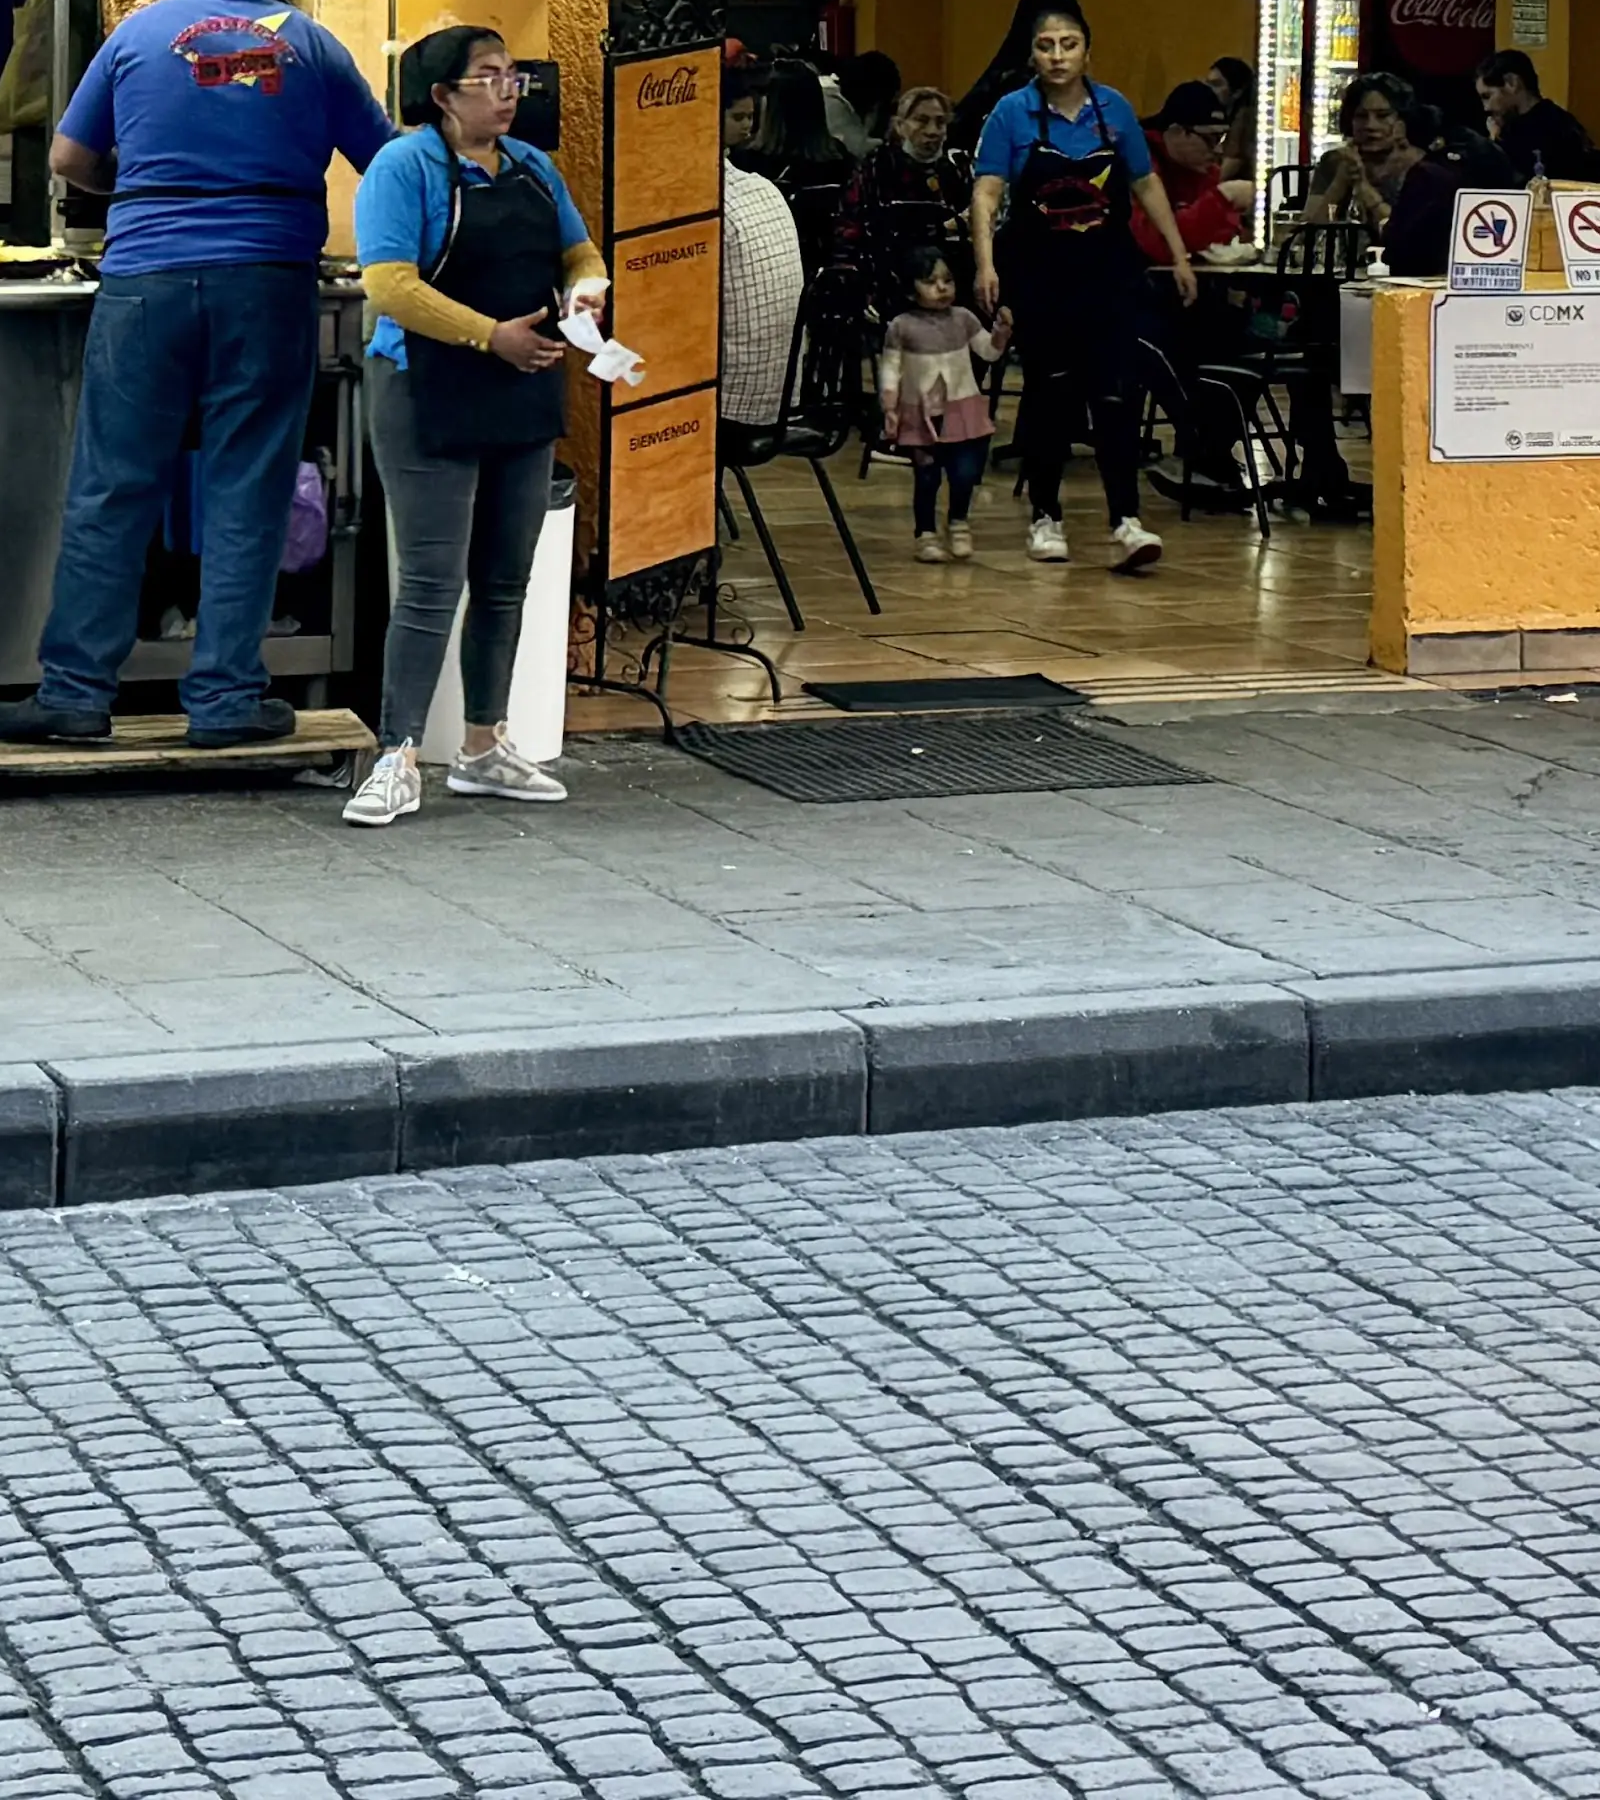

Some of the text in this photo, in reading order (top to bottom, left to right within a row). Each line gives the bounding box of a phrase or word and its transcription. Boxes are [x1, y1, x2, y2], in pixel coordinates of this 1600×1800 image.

[625, 241, 708, 272] RESTAURANTE
[1574, 269, 1591, 281] NO
[1529, 305, 1585, 321] CDMX
[629, 420, 700, 451] BIENVENIDO
